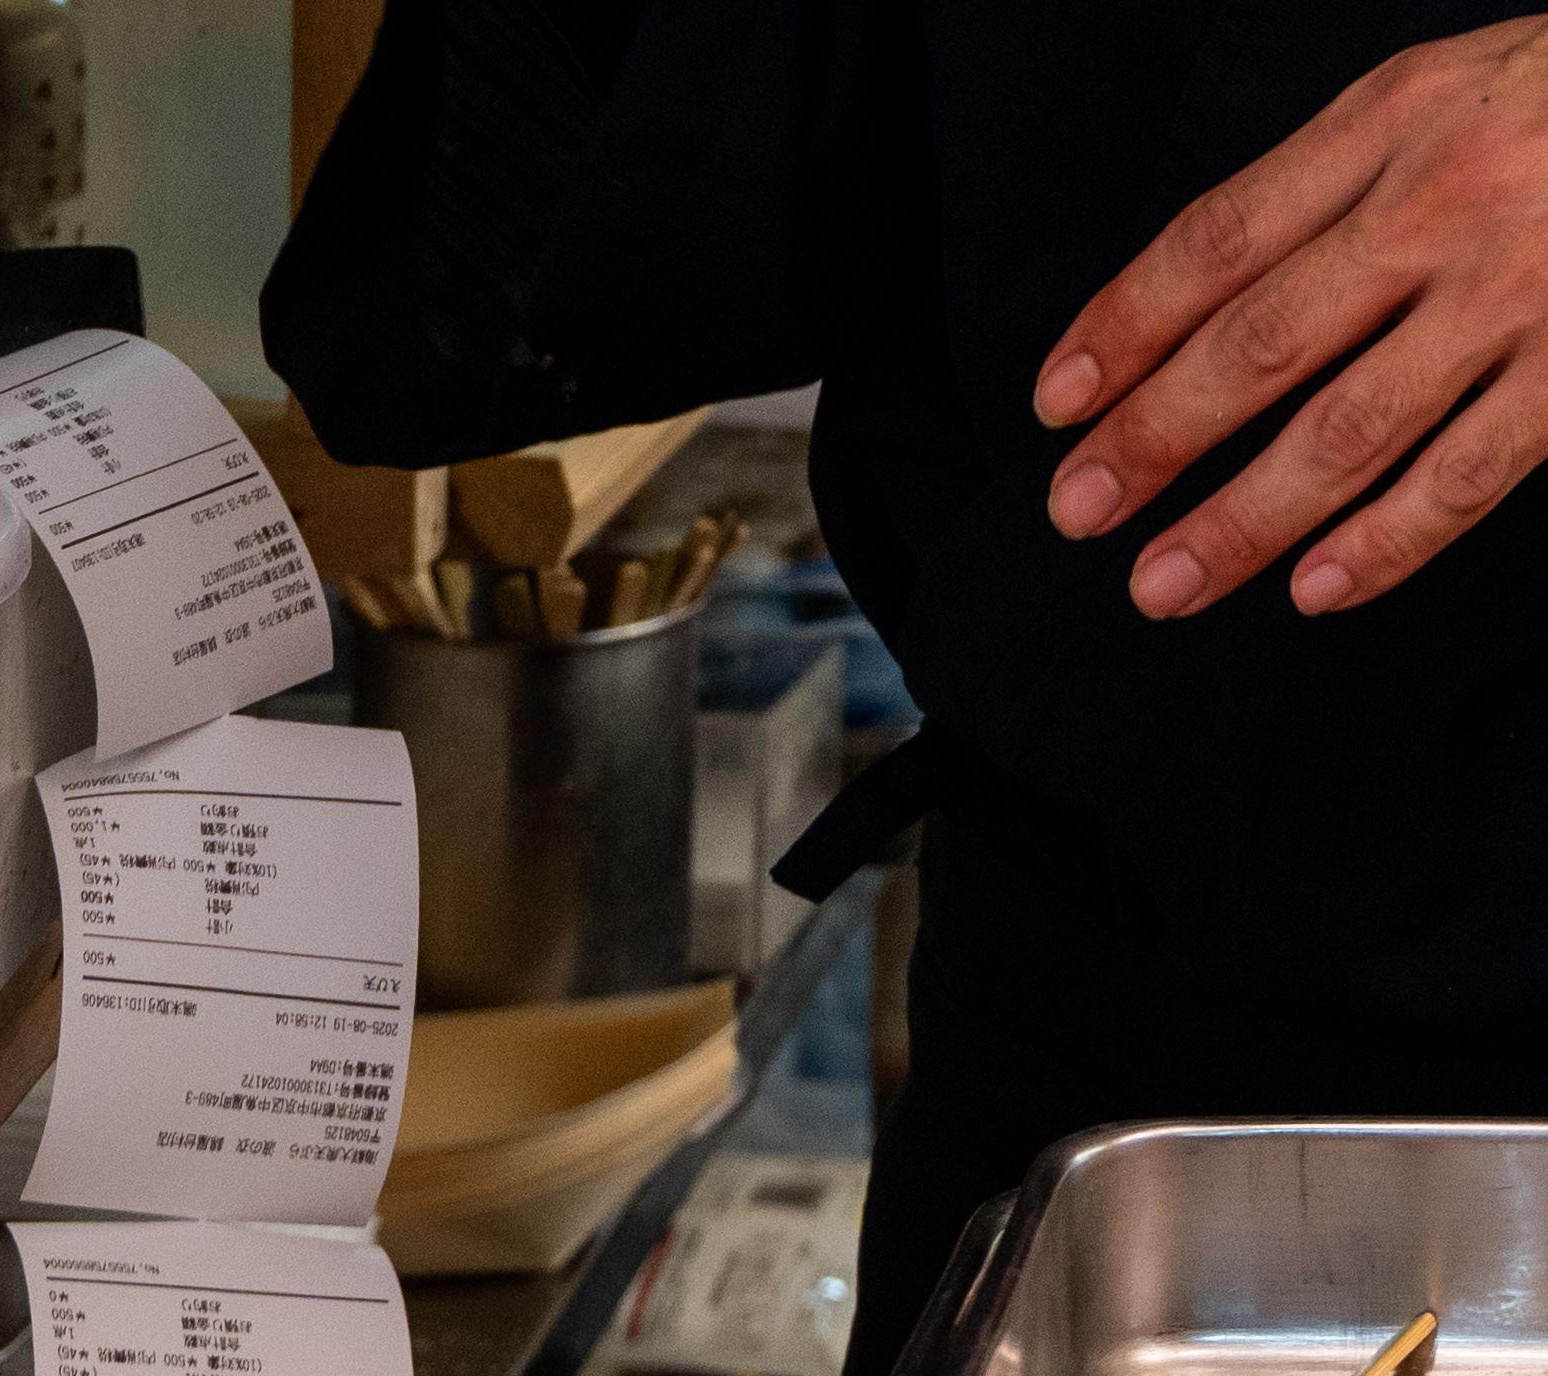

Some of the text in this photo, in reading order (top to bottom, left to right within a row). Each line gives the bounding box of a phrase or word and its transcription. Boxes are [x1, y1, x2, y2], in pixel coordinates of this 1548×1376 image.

[80, 889, 115, 904] ¥500
[82, 908, 116, 925] ¥500
[82, 949, 116, 966] ¥500
